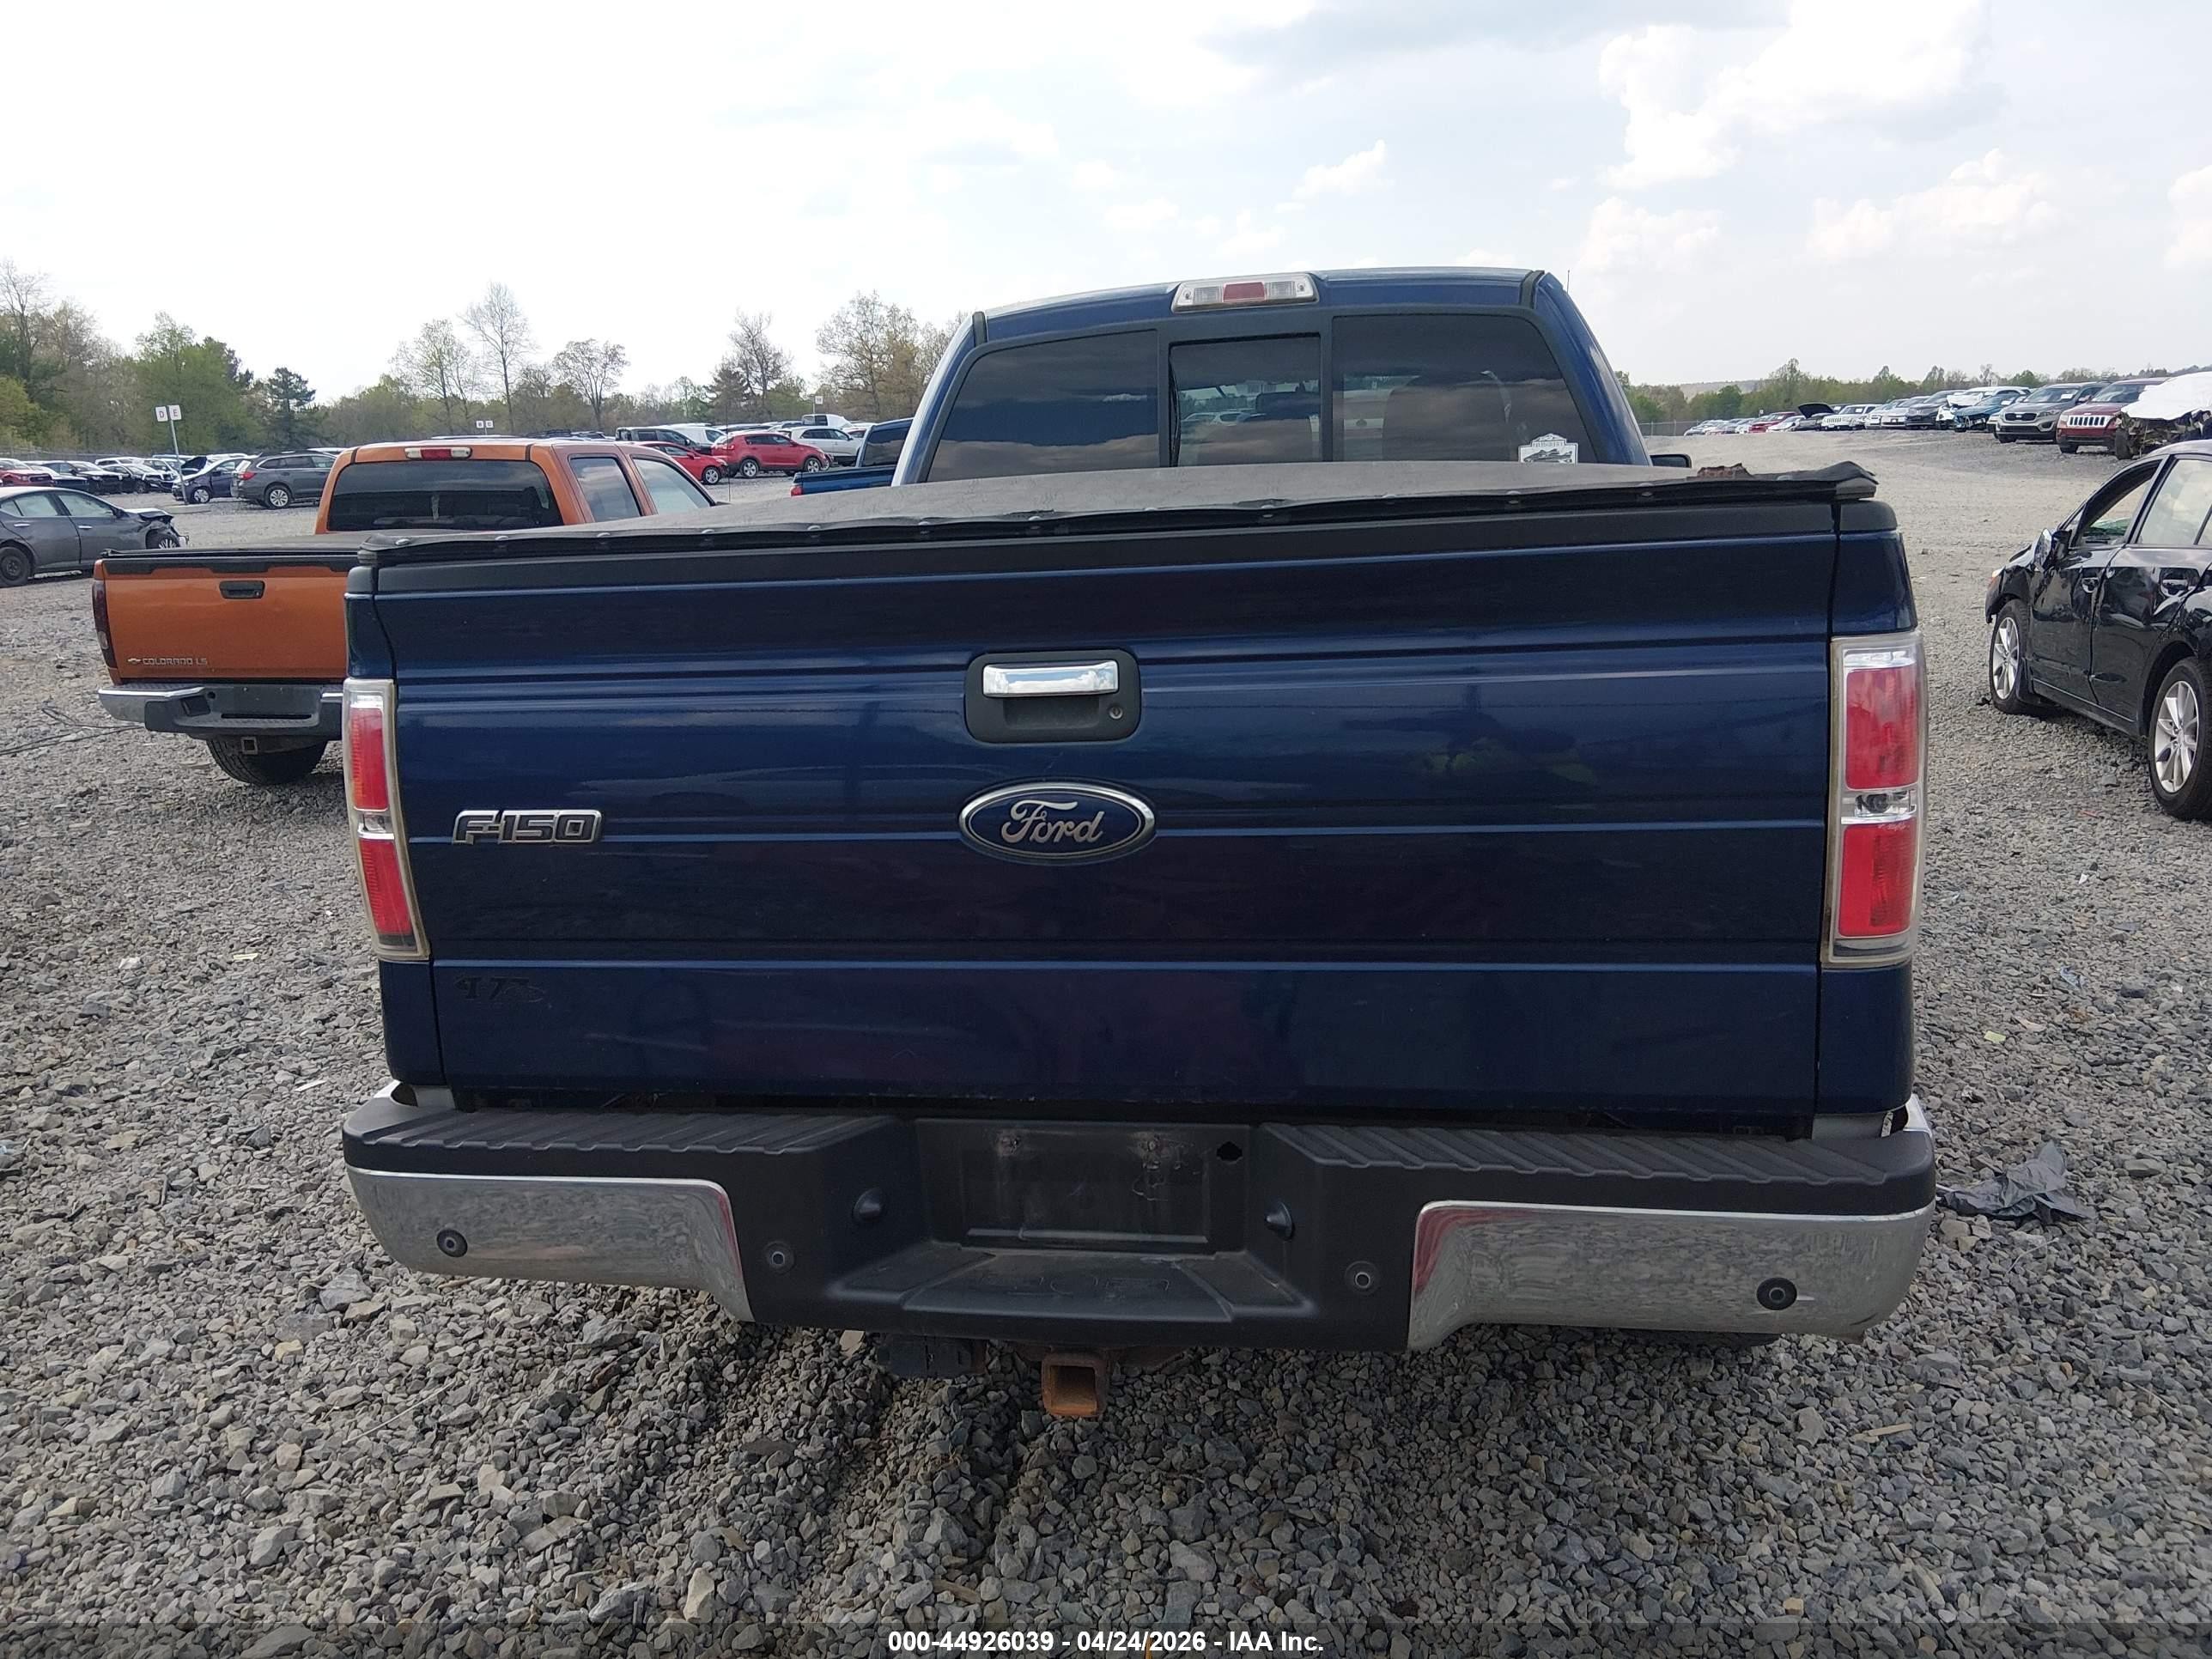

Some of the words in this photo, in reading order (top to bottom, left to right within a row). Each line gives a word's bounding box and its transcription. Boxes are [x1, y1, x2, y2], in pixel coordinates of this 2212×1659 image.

[173, 409, 179, 417] E
[452, 809, 602, 845] F-150
[1000, 799, 1106, 844] Ford
